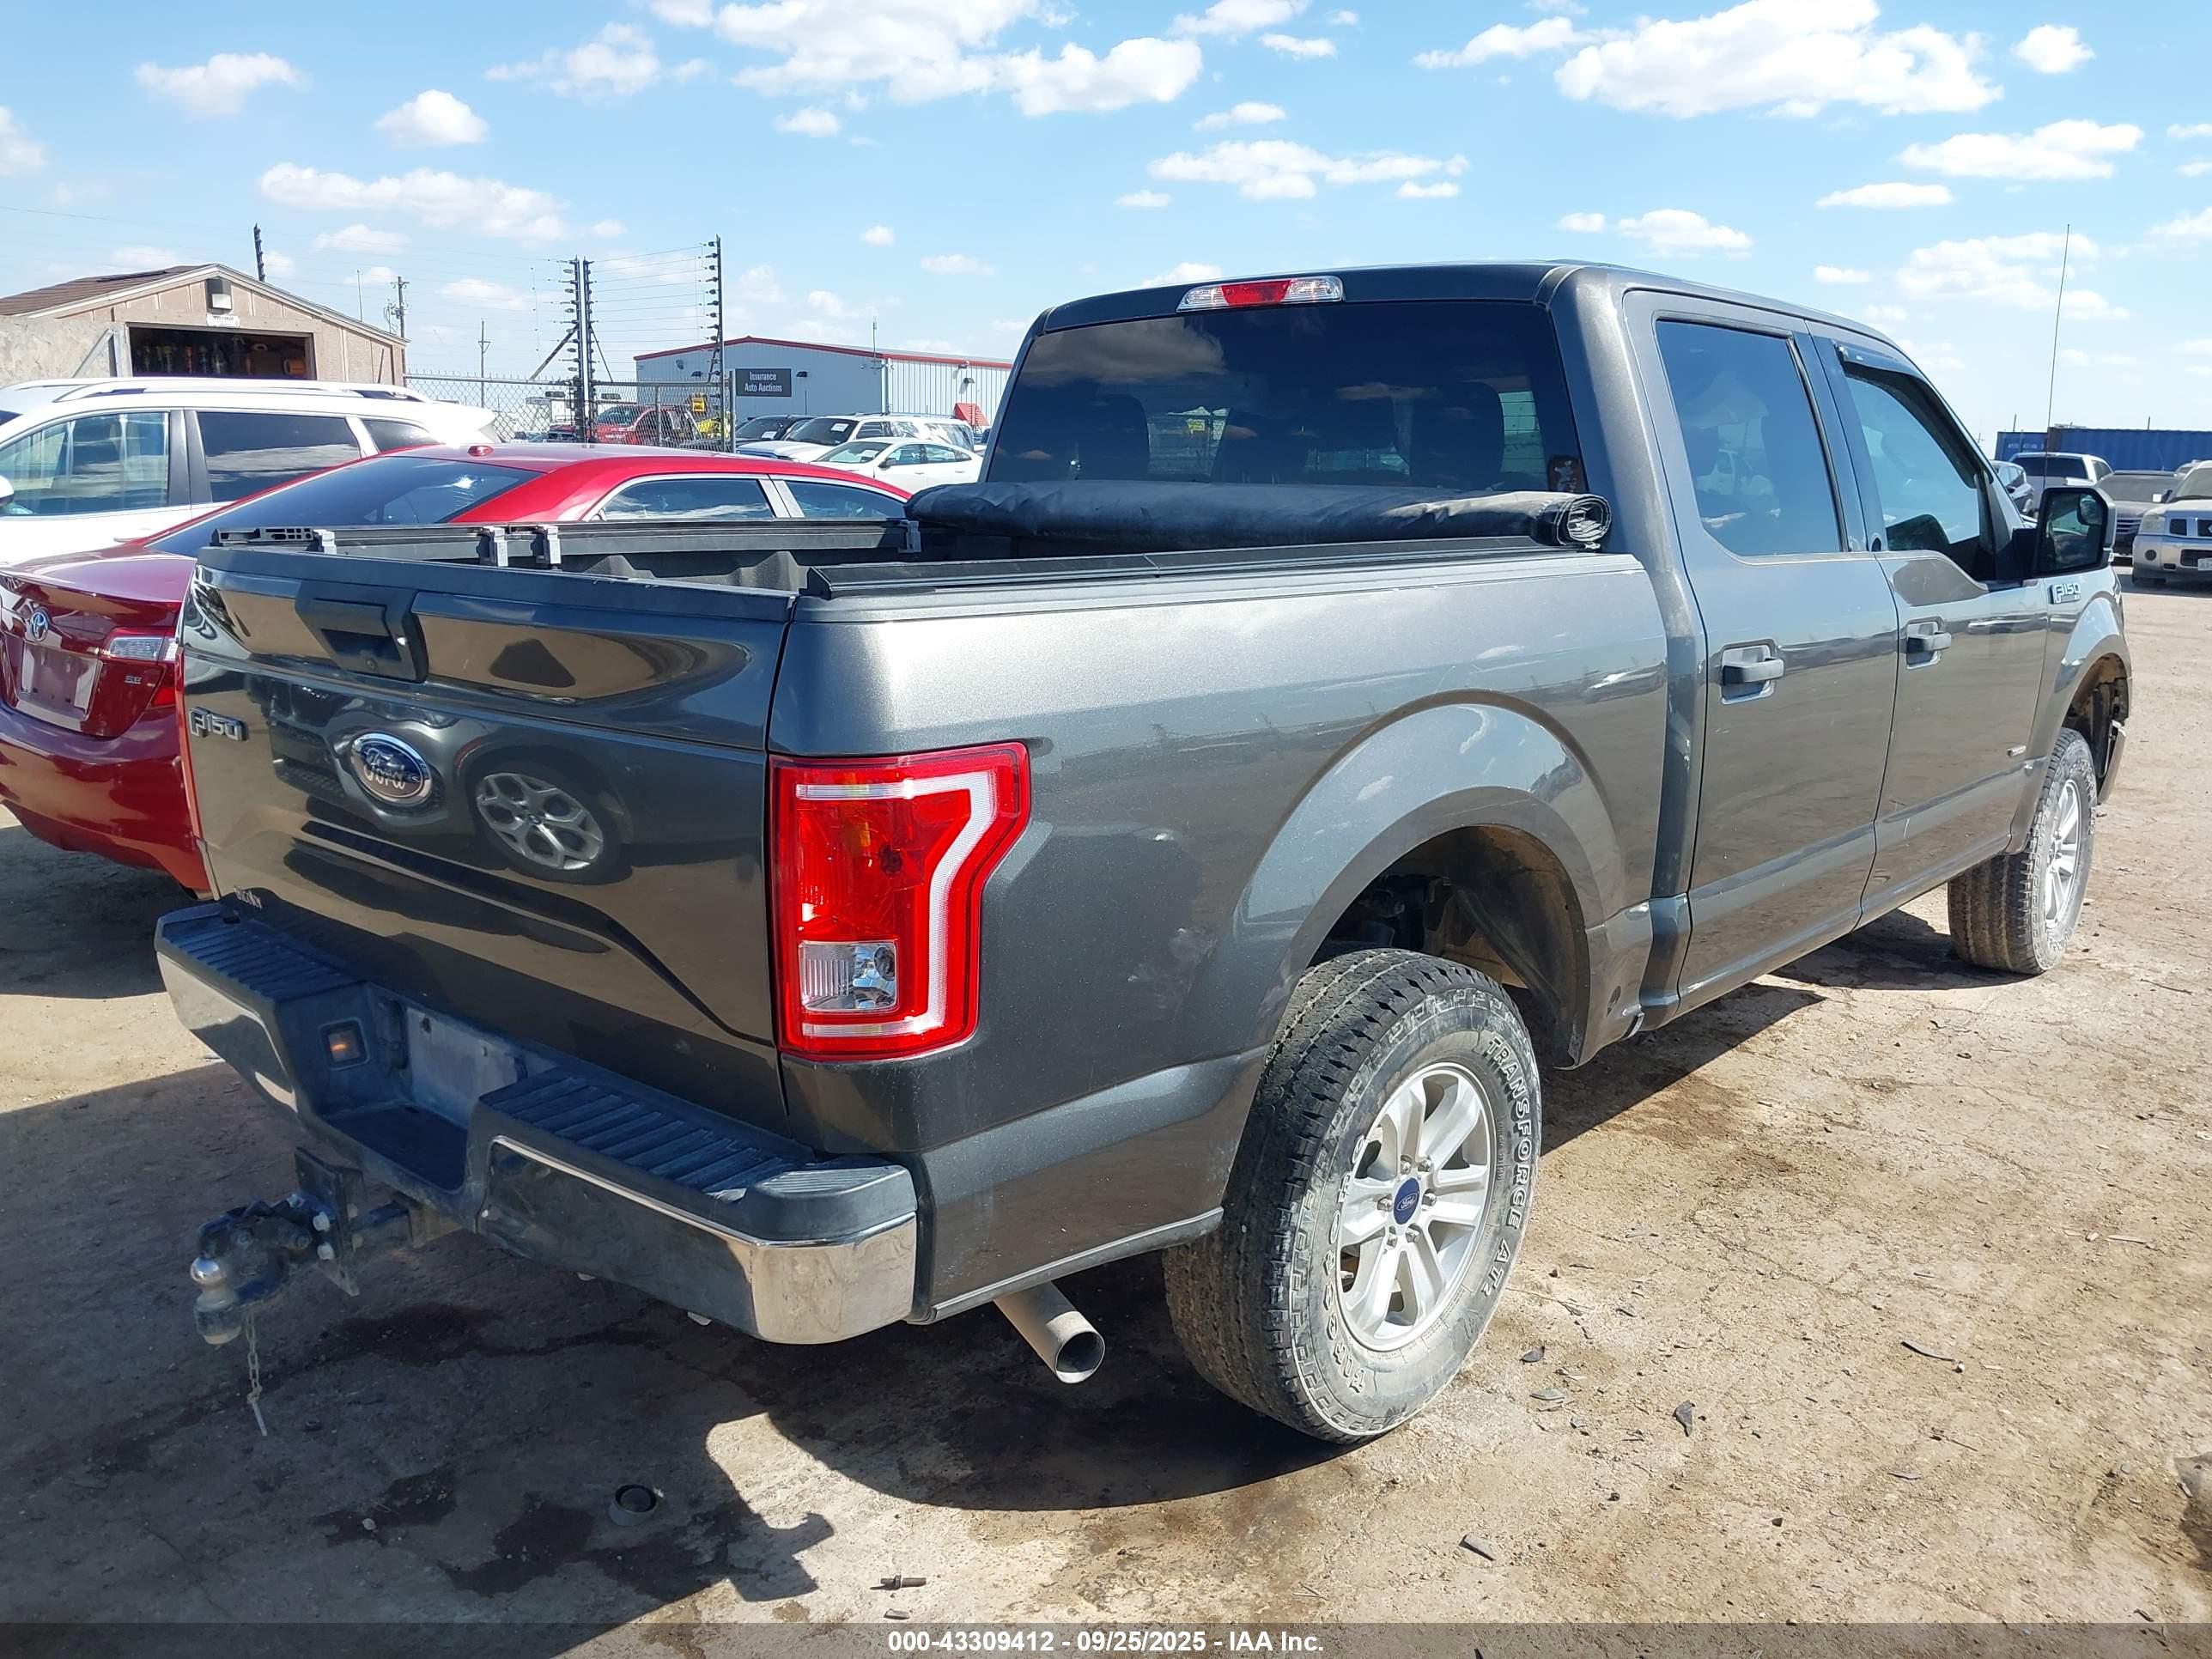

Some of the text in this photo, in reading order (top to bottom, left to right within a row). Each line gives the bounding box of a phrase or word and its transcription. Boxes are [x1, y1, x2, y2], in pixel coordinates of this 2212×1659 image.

[744, 382, 782, 392] Auto Auctions
[749, 371, 777, 381] Insurance
[363, 746, 407, 790] Ford
[1485, 1036, 1533, 1231] TRANSFORCE
